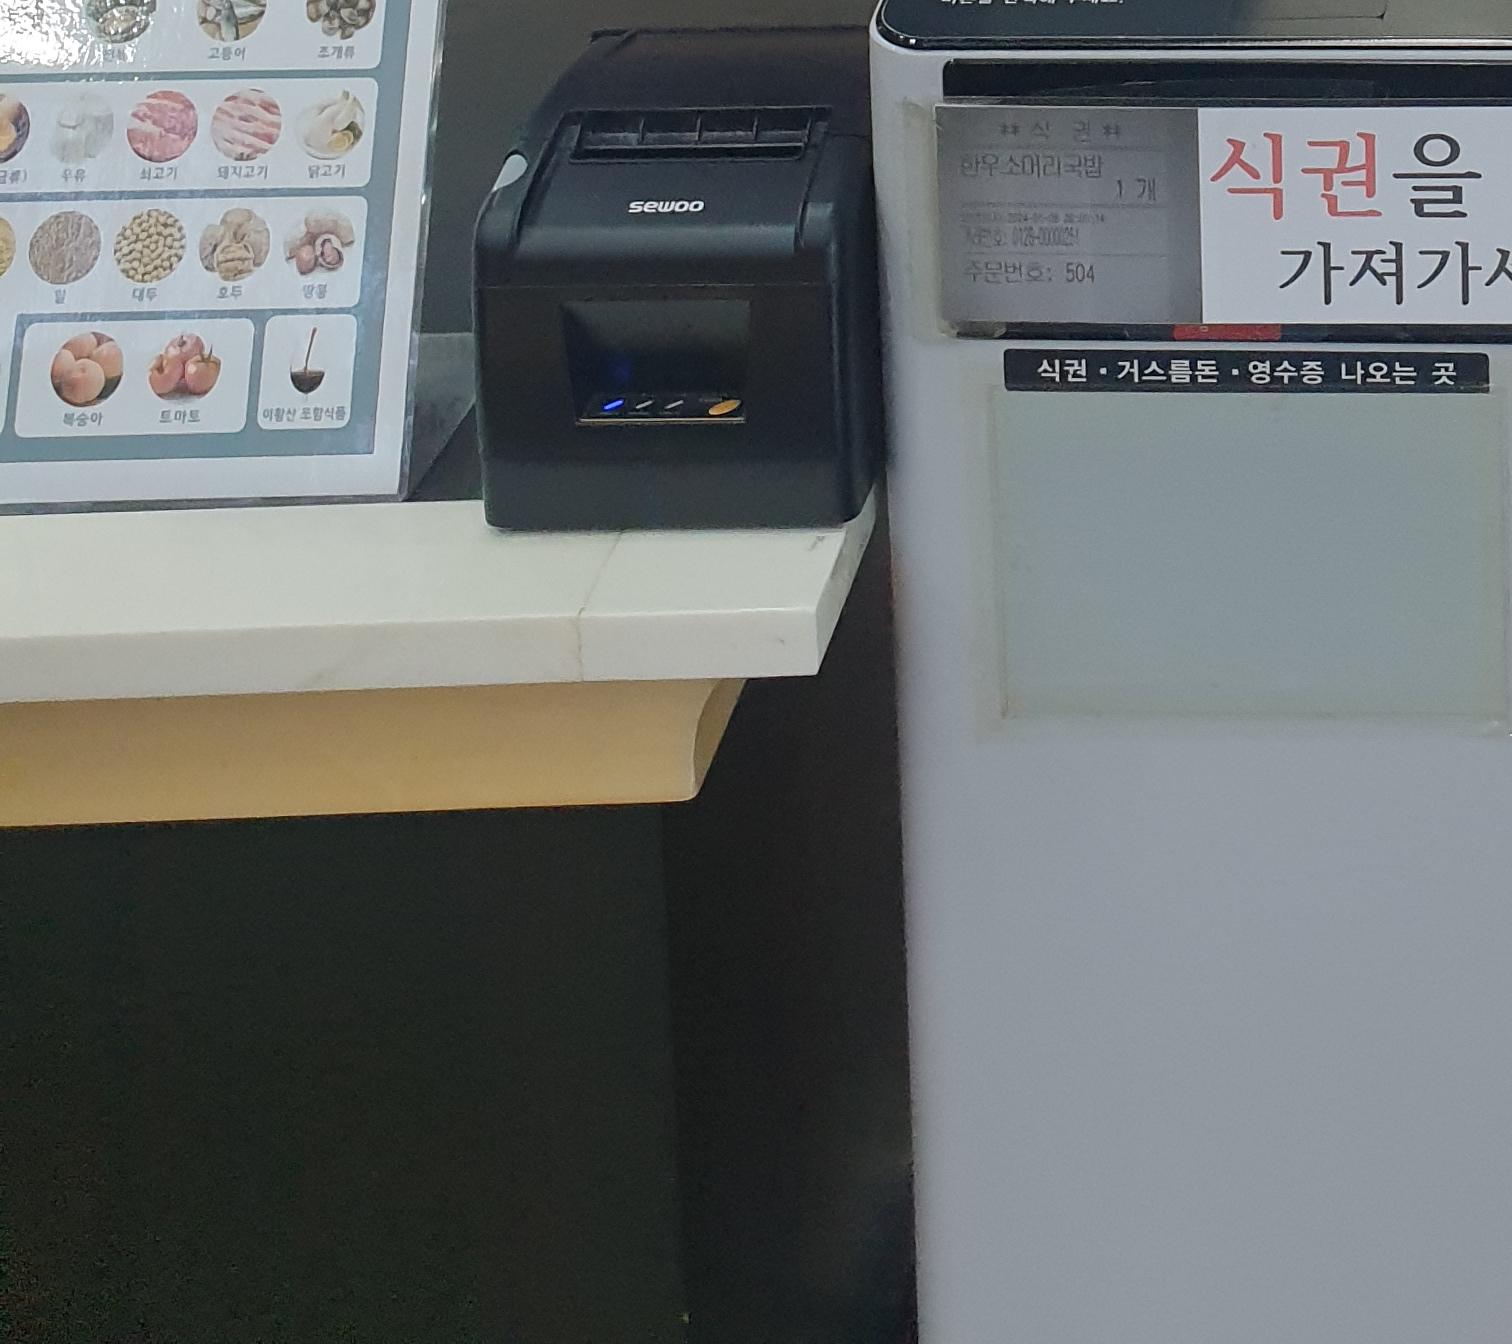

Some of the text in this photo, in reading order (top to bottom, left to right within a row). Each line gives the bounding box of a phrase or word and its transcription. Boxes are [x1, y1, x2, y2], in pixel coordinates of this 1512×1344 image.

[1210, 127, 1485, 226] 식권을
[1064, 262, 1096, 284] 504
[1037, 358, 1459, 388] 식권 거스름돈 영수증 나오는 곳
